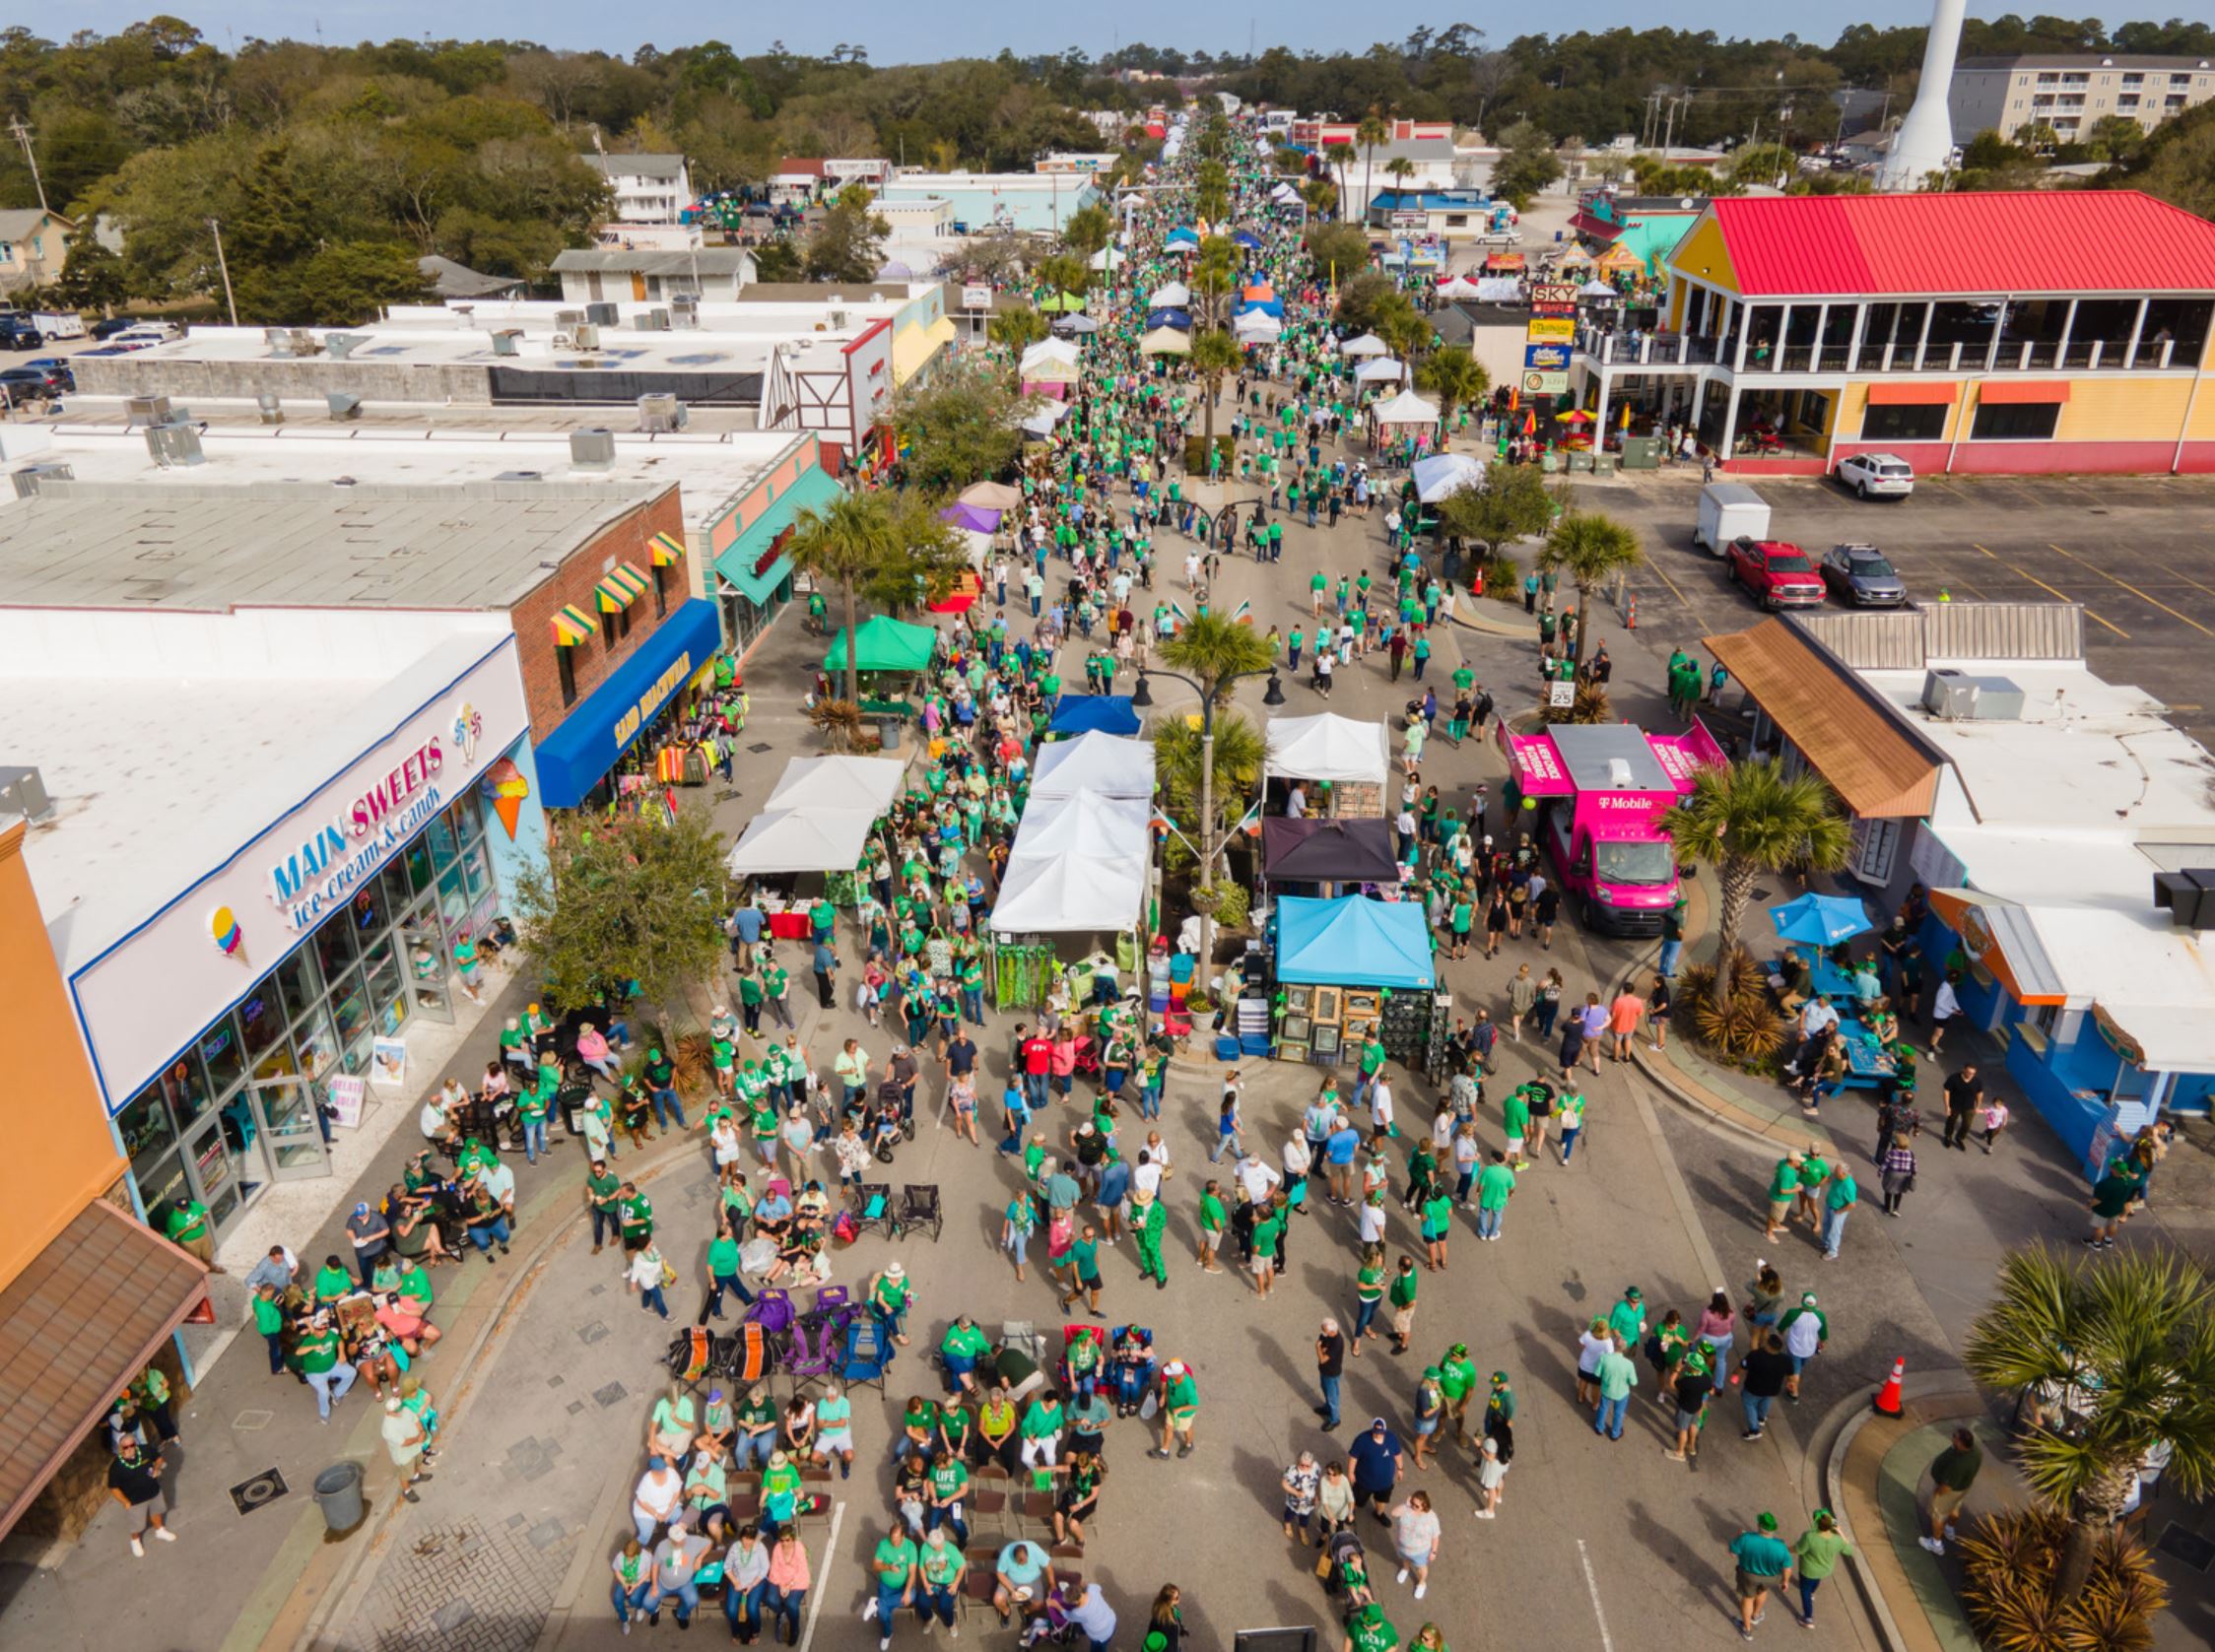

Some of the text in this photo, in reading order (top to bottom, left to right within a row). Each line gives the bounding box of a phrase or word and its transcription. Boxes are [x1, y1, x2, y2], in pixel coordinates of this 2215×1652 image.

[1534, 287, 1577, 301] SKY
[1553, 694, 1572, 704] 25
[1611, 797, 1652, 809] Mobile
[272, 736, 442, 903] MAIN SWEETS
[292, 785, 440, 929] ice cream & candy
[936, 1469, 957, 1483] LIFE
